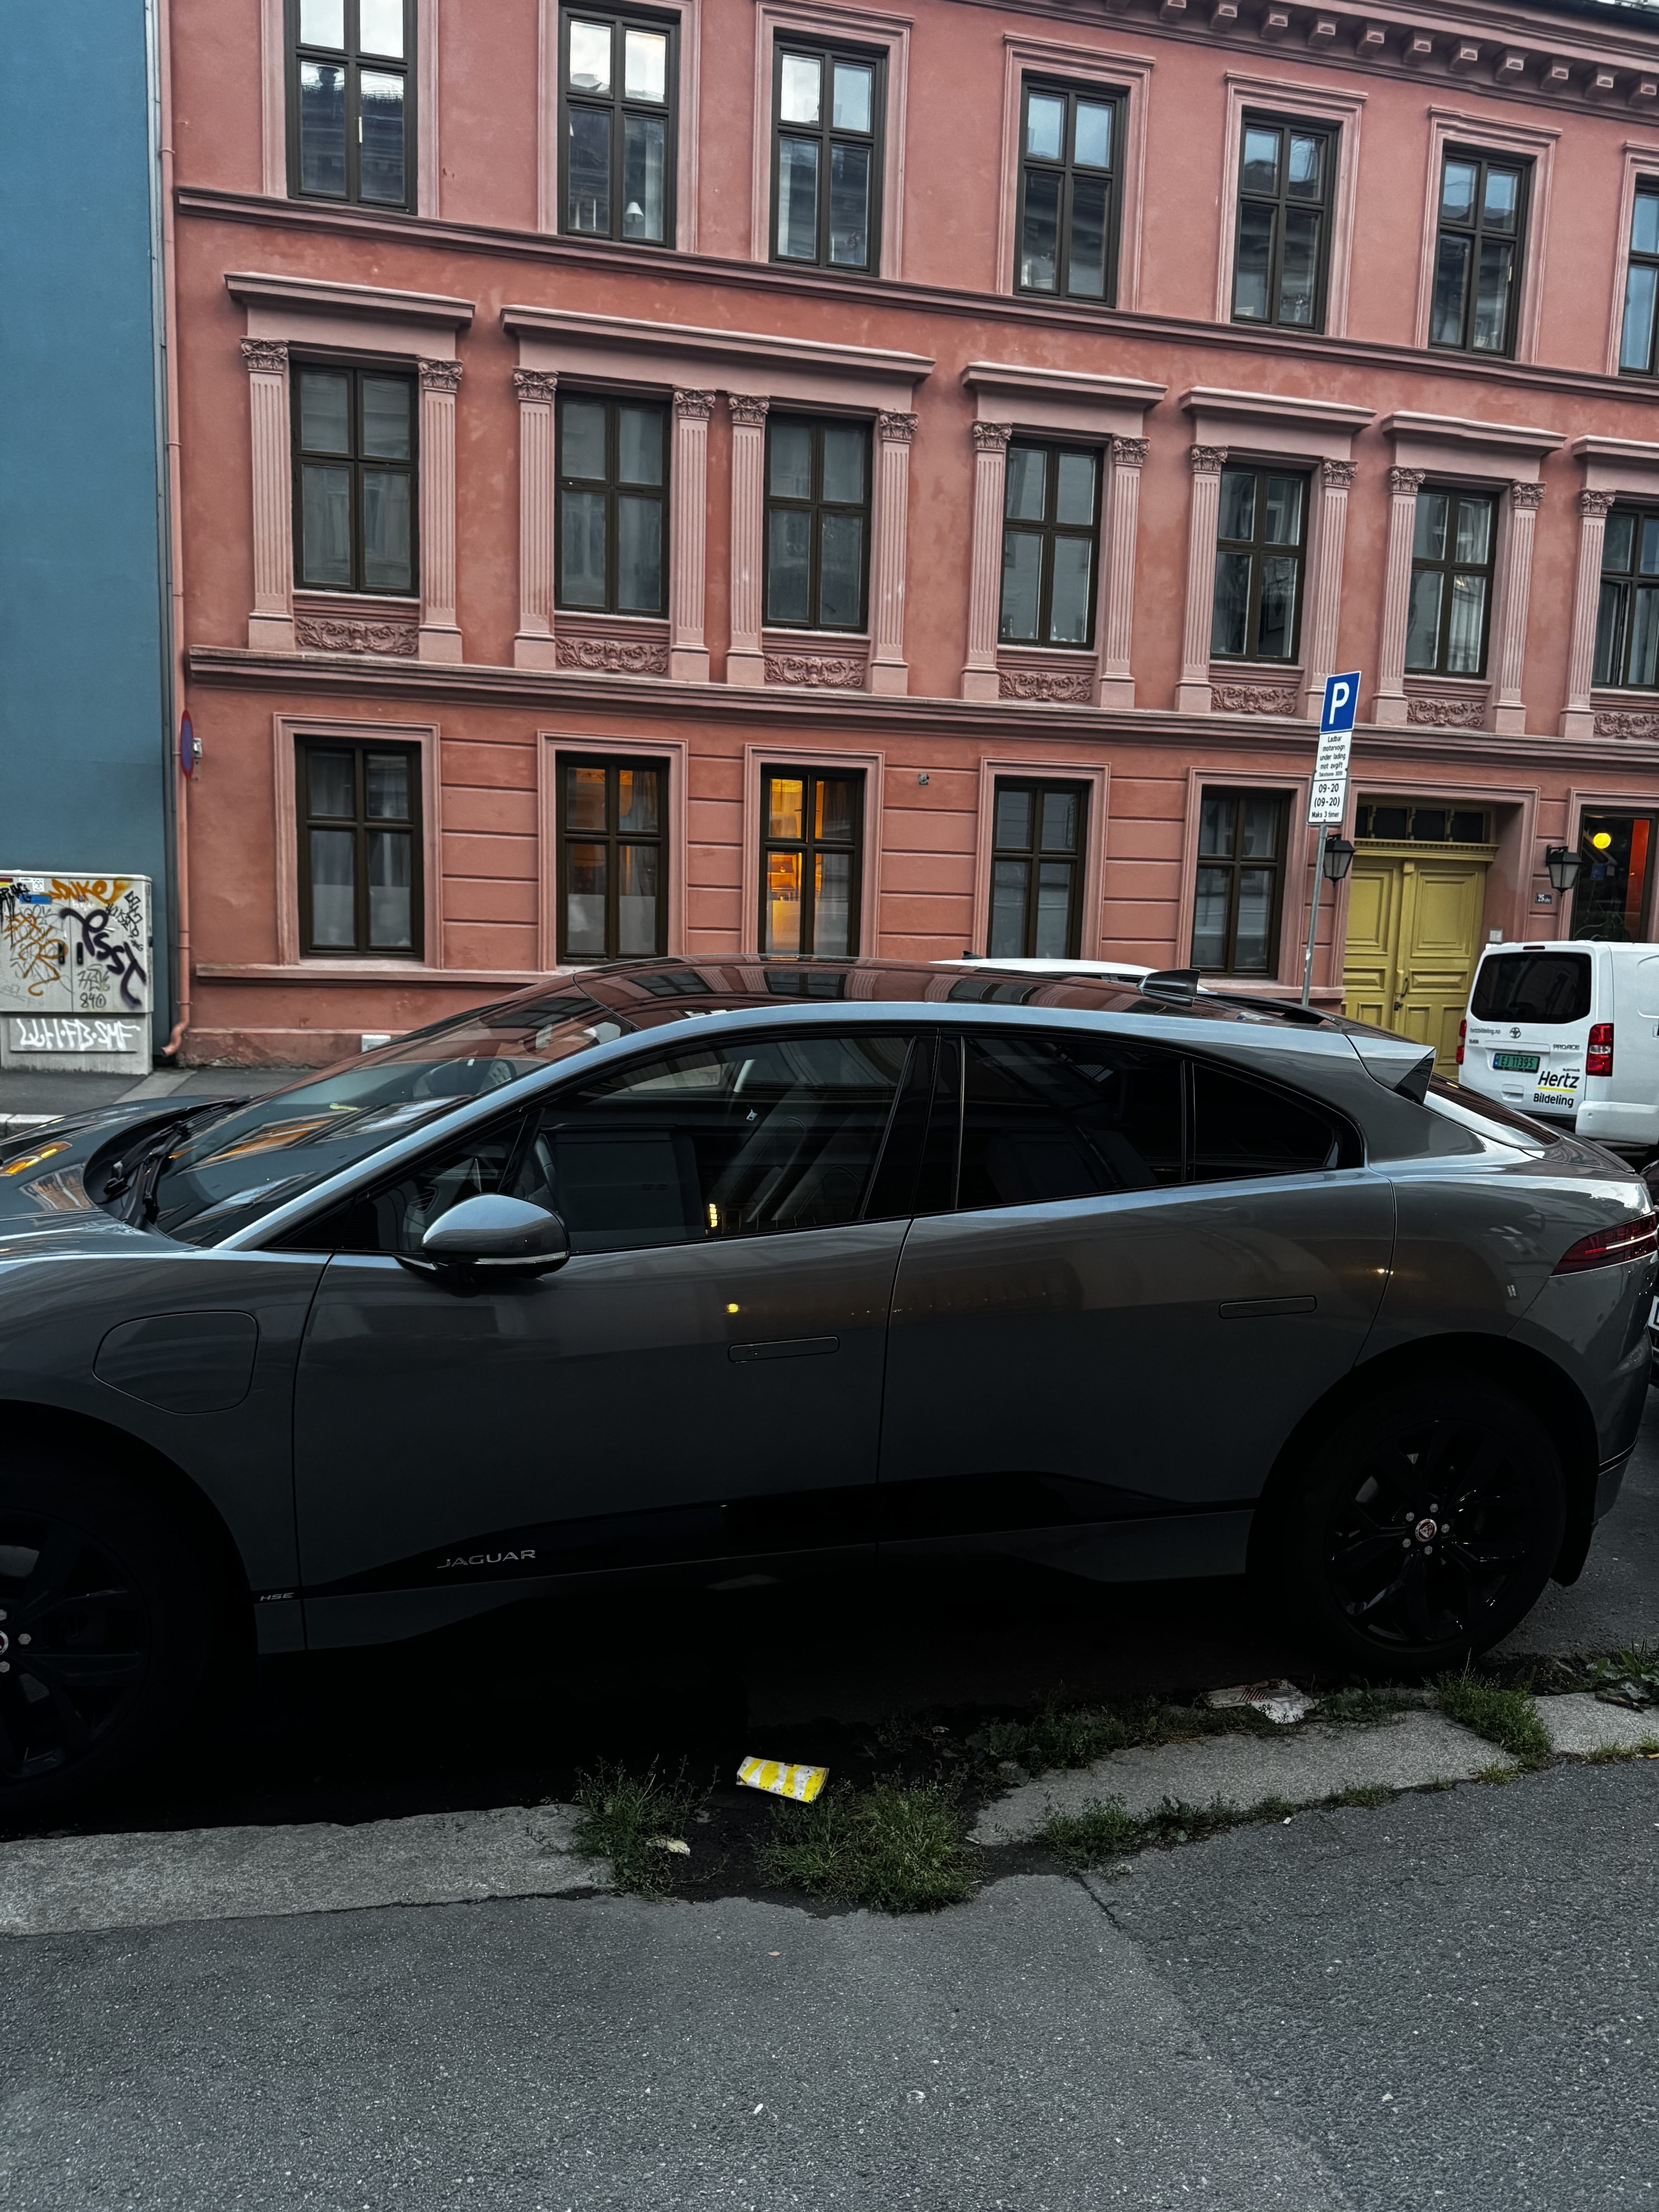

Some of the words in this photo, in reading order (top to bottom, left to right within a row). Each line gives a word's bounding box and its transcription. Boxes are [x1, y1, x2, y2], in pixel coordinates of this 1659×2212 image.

[1329, 682, 1350, 725] P
[1333, 752, 1346, 761] lading
[1330, 761, 1343, 770] avgift
[1501, 1056, 1510, 1066] EJ
[1512, 1057, 1534, 1068] 11395
[1538, 1071, 1580, 1089] Hertz
[1533, 1092, 1574, 1108] Bildeling
[437, 1549, 536, 1568] JAGUAR
[260, 1592, 294, 1601] HSE
